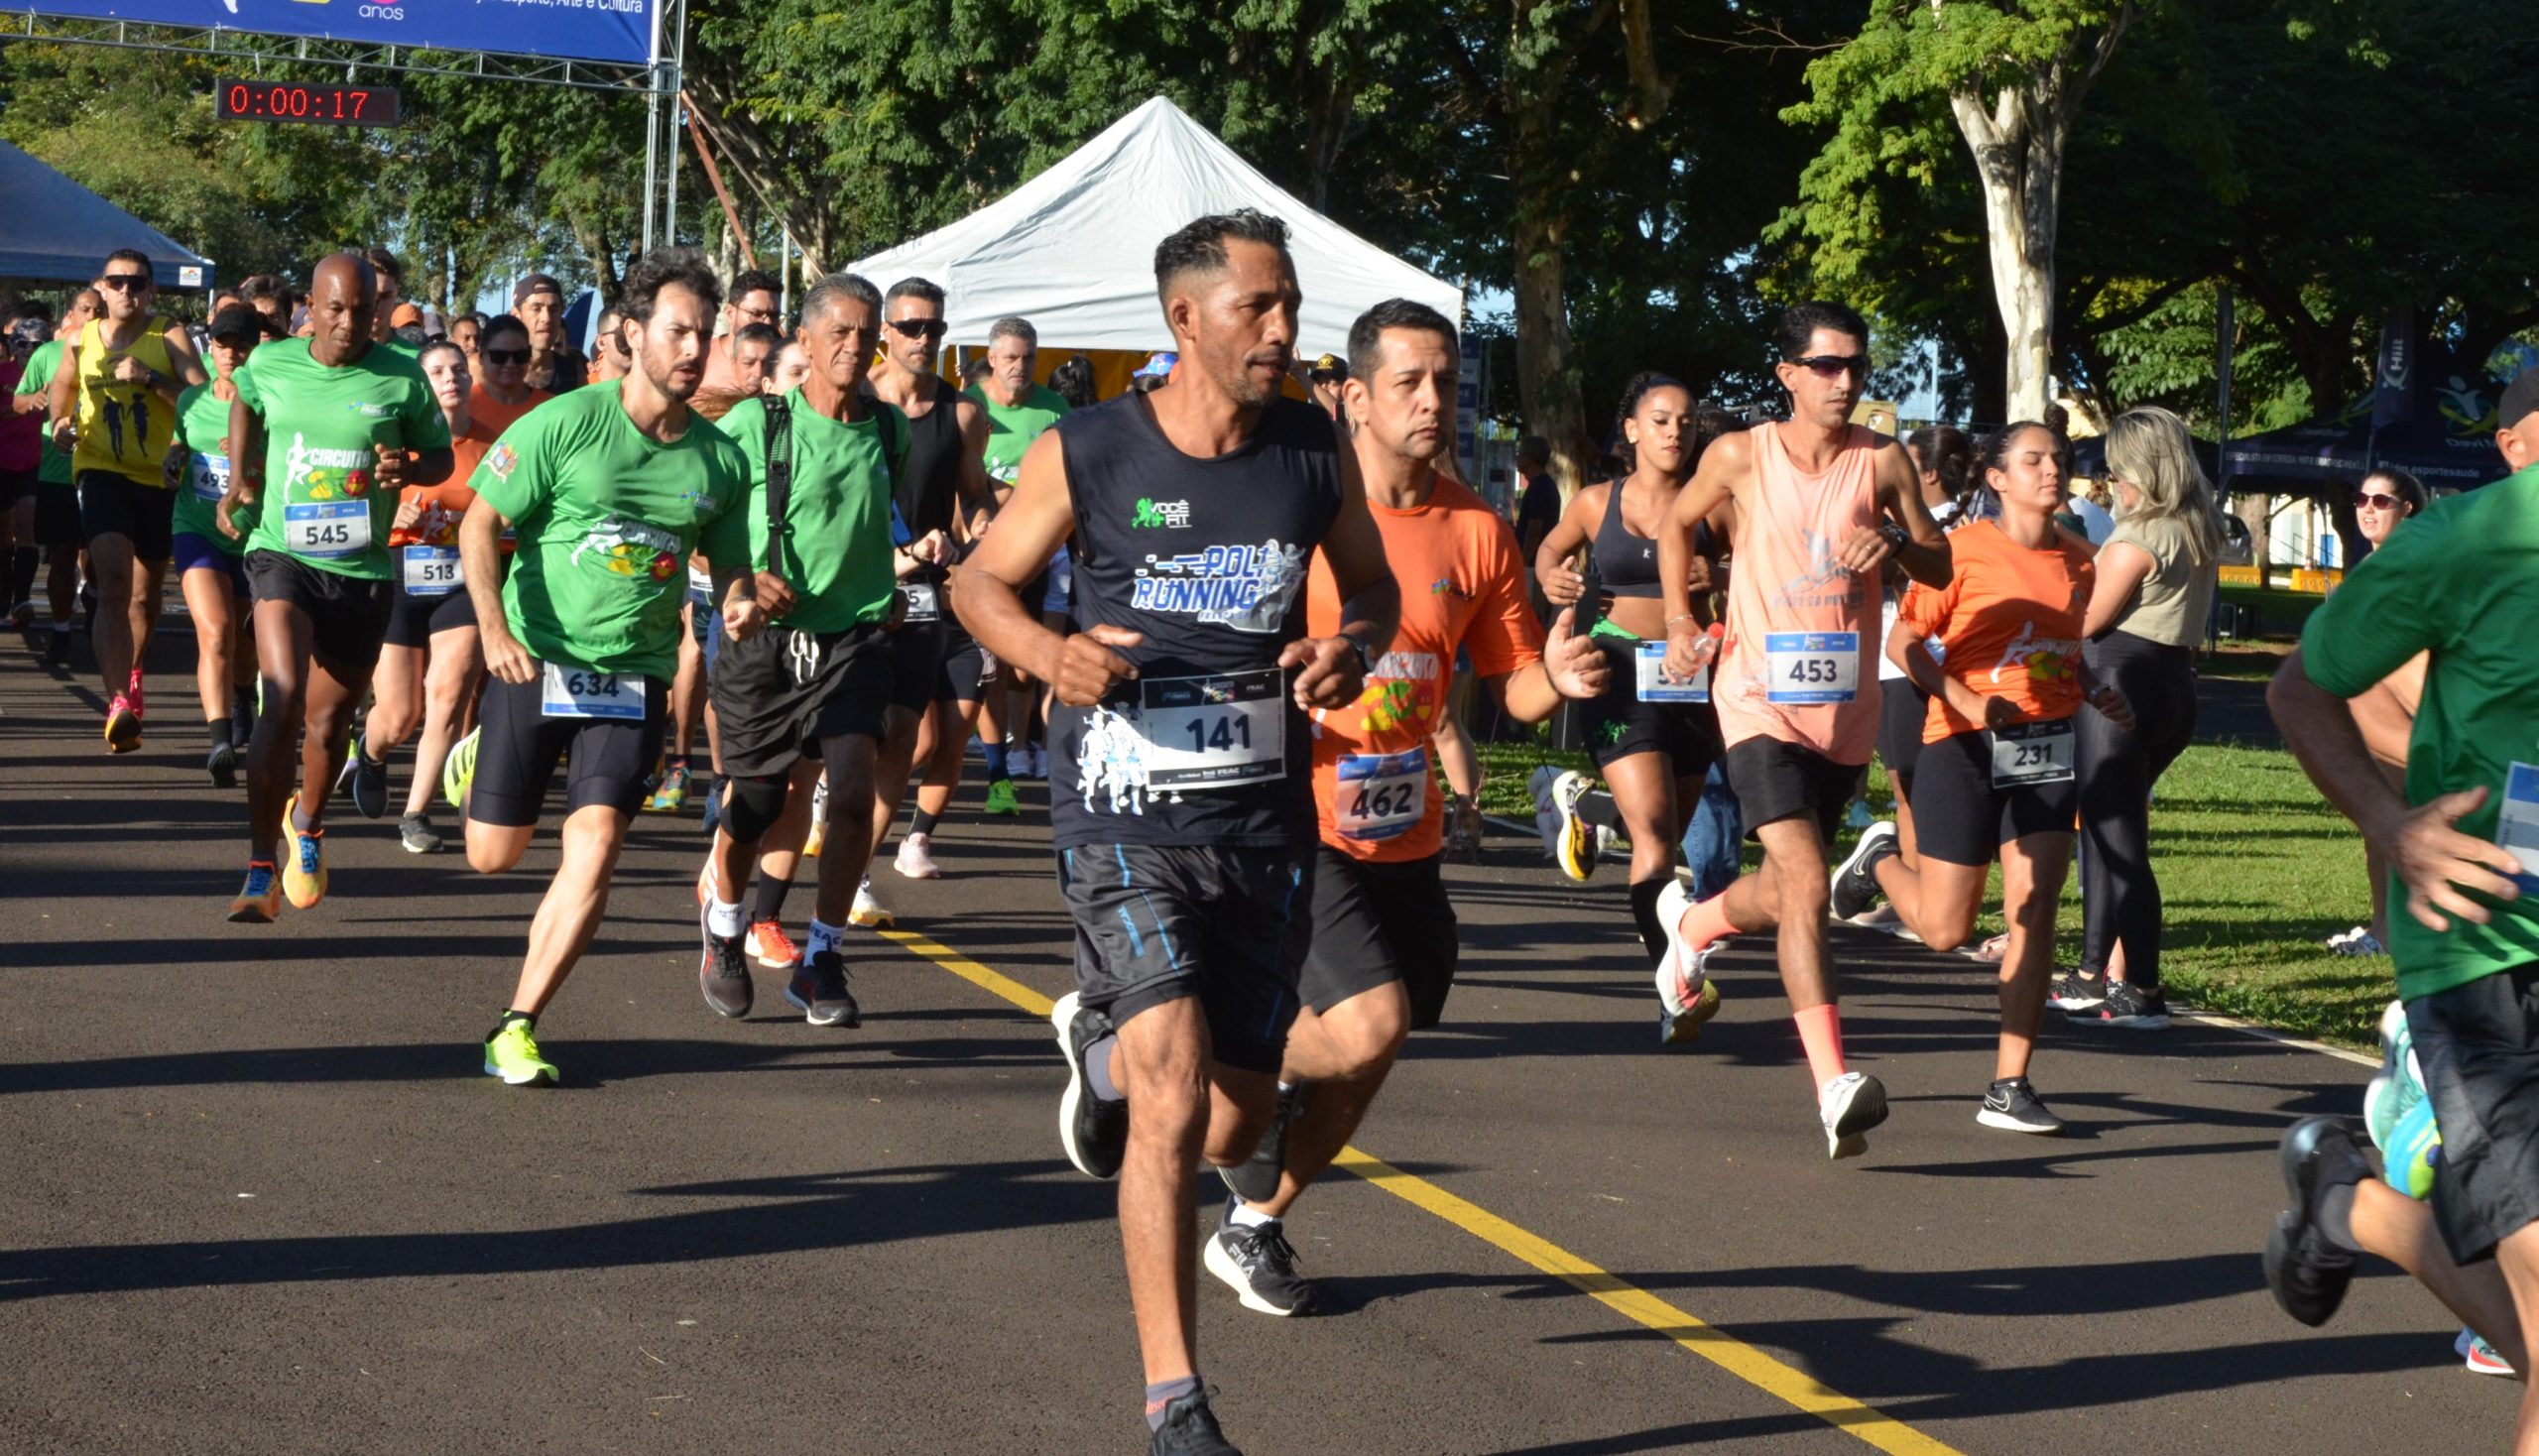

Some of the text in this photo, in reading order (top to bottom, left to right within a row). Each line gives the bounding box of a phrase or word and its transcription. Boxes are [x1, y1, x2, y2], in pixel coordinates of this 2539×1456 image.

[359, 4, 404, 21] anos
[599, 0, 643, 13] Cultura
[230, 84, 368, 120] 0:00:17
[309, 447, 371, 468] CIRCUITO
[200, 471, 228, 488] 493
[1150, 499, 1190, 514] VOCÊ
[305, 524, 349, 546] 545
[423, 564, 454, 580] 513
[1131, 577, 1265, 612] RUNNING
[1789, 660, 1837, 682] 453
[567, 672, 620, 697] 634
[1185, 713, 1251, 754] 141
[2014, 743, 2052, 767] 231
[1351, 783, 1413, 820] 462
[1229, 1242, 1256, 1280] FILA
